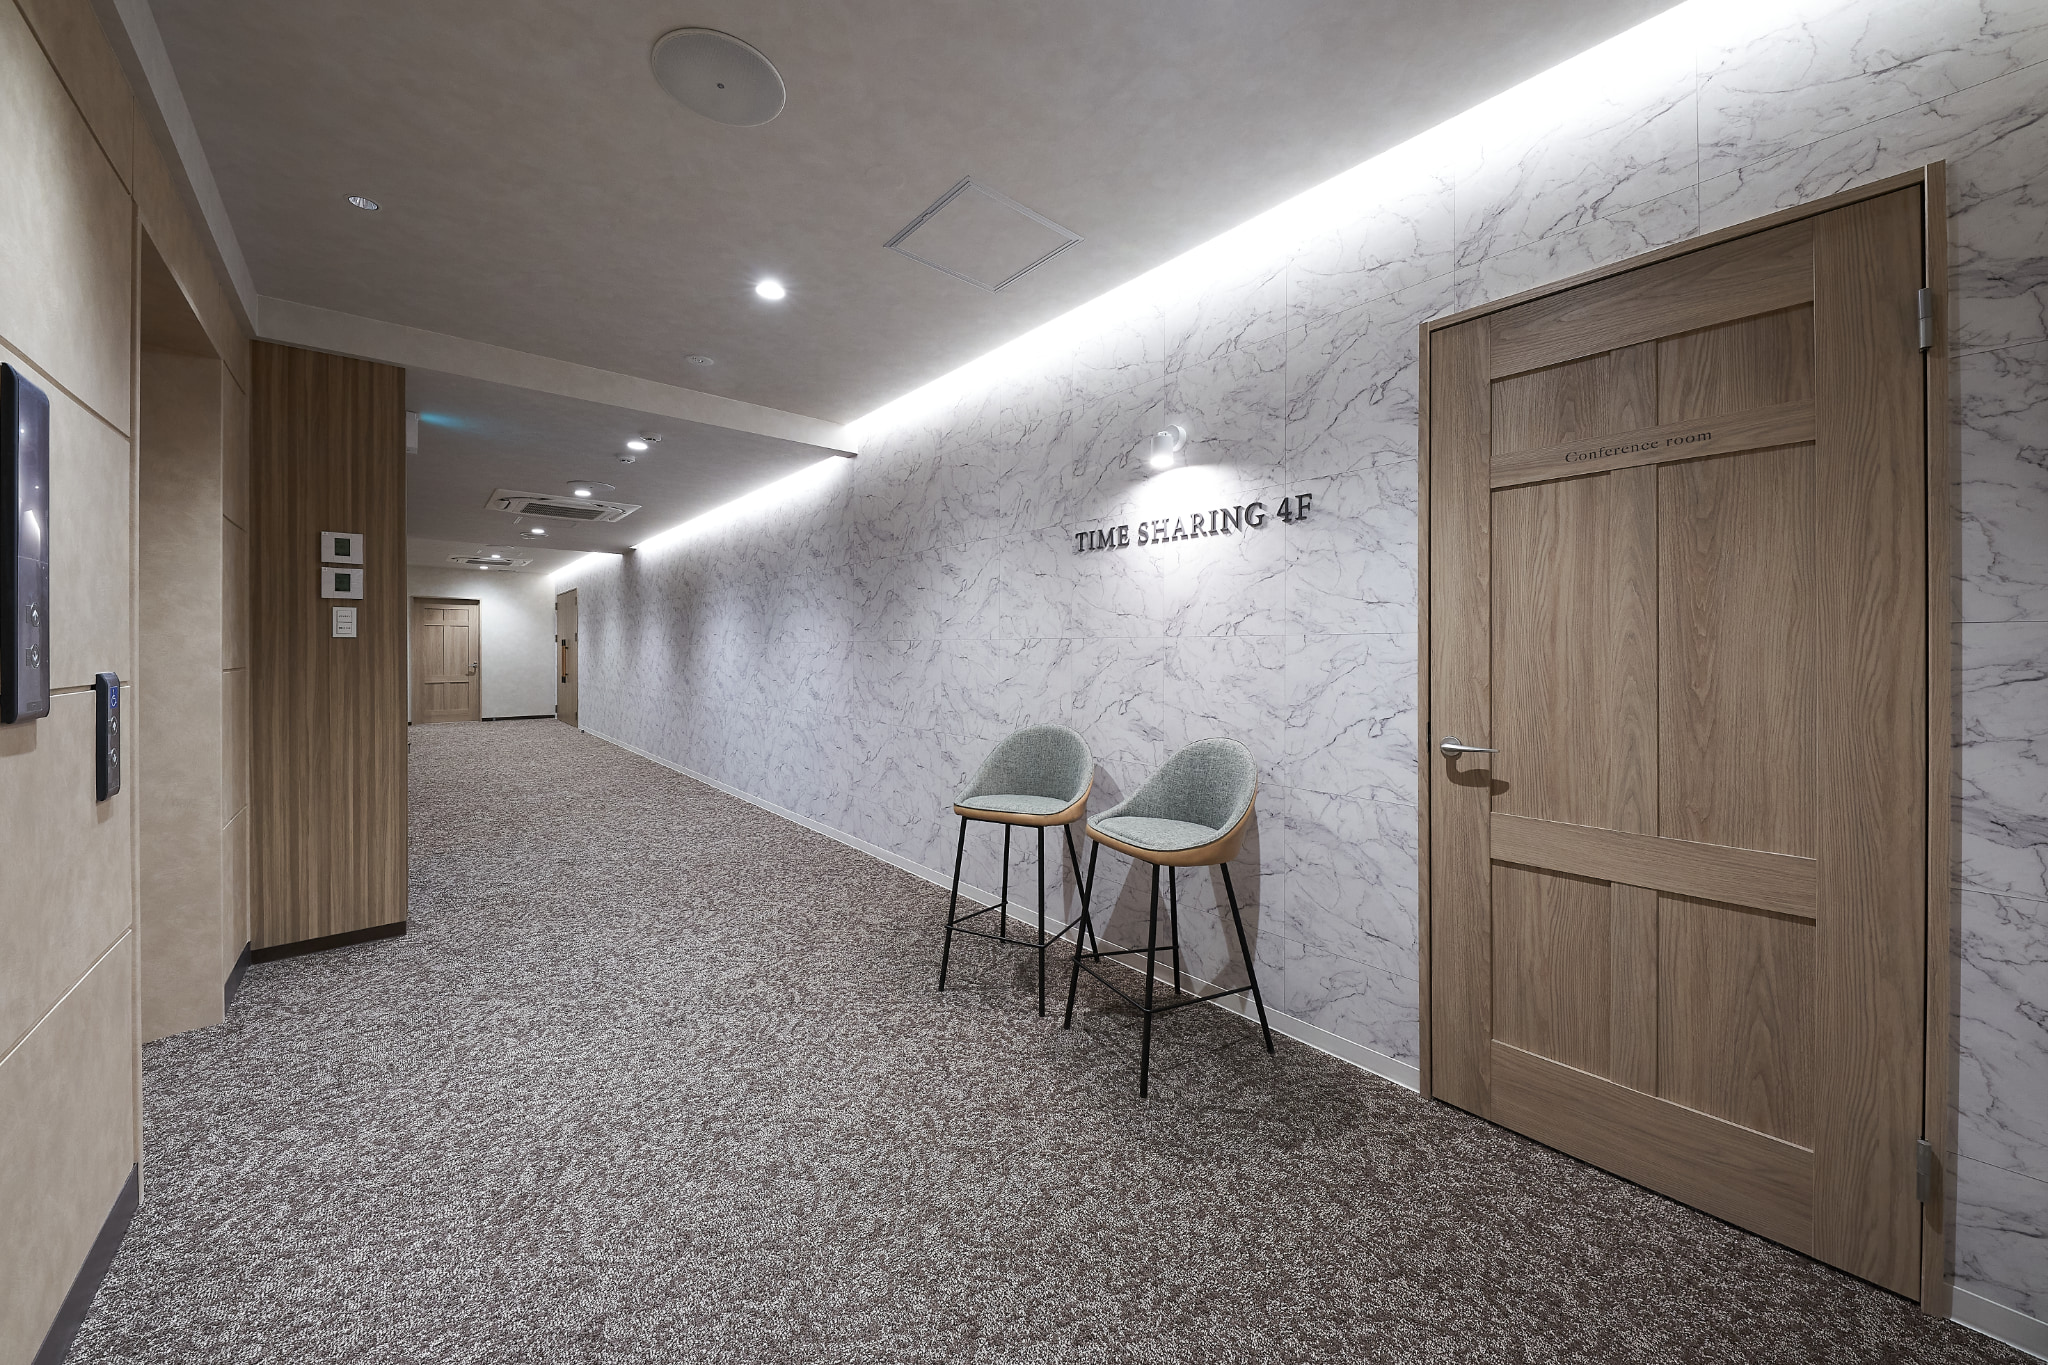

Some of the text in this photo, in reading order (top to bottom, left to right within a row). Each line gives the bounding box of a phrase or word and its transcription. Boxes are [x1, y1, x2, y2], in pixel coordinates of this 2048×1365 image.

[1565, 431, 1712, 463] Conference room
[1075, 492, 1313, 552] TIME SHARING 4F
